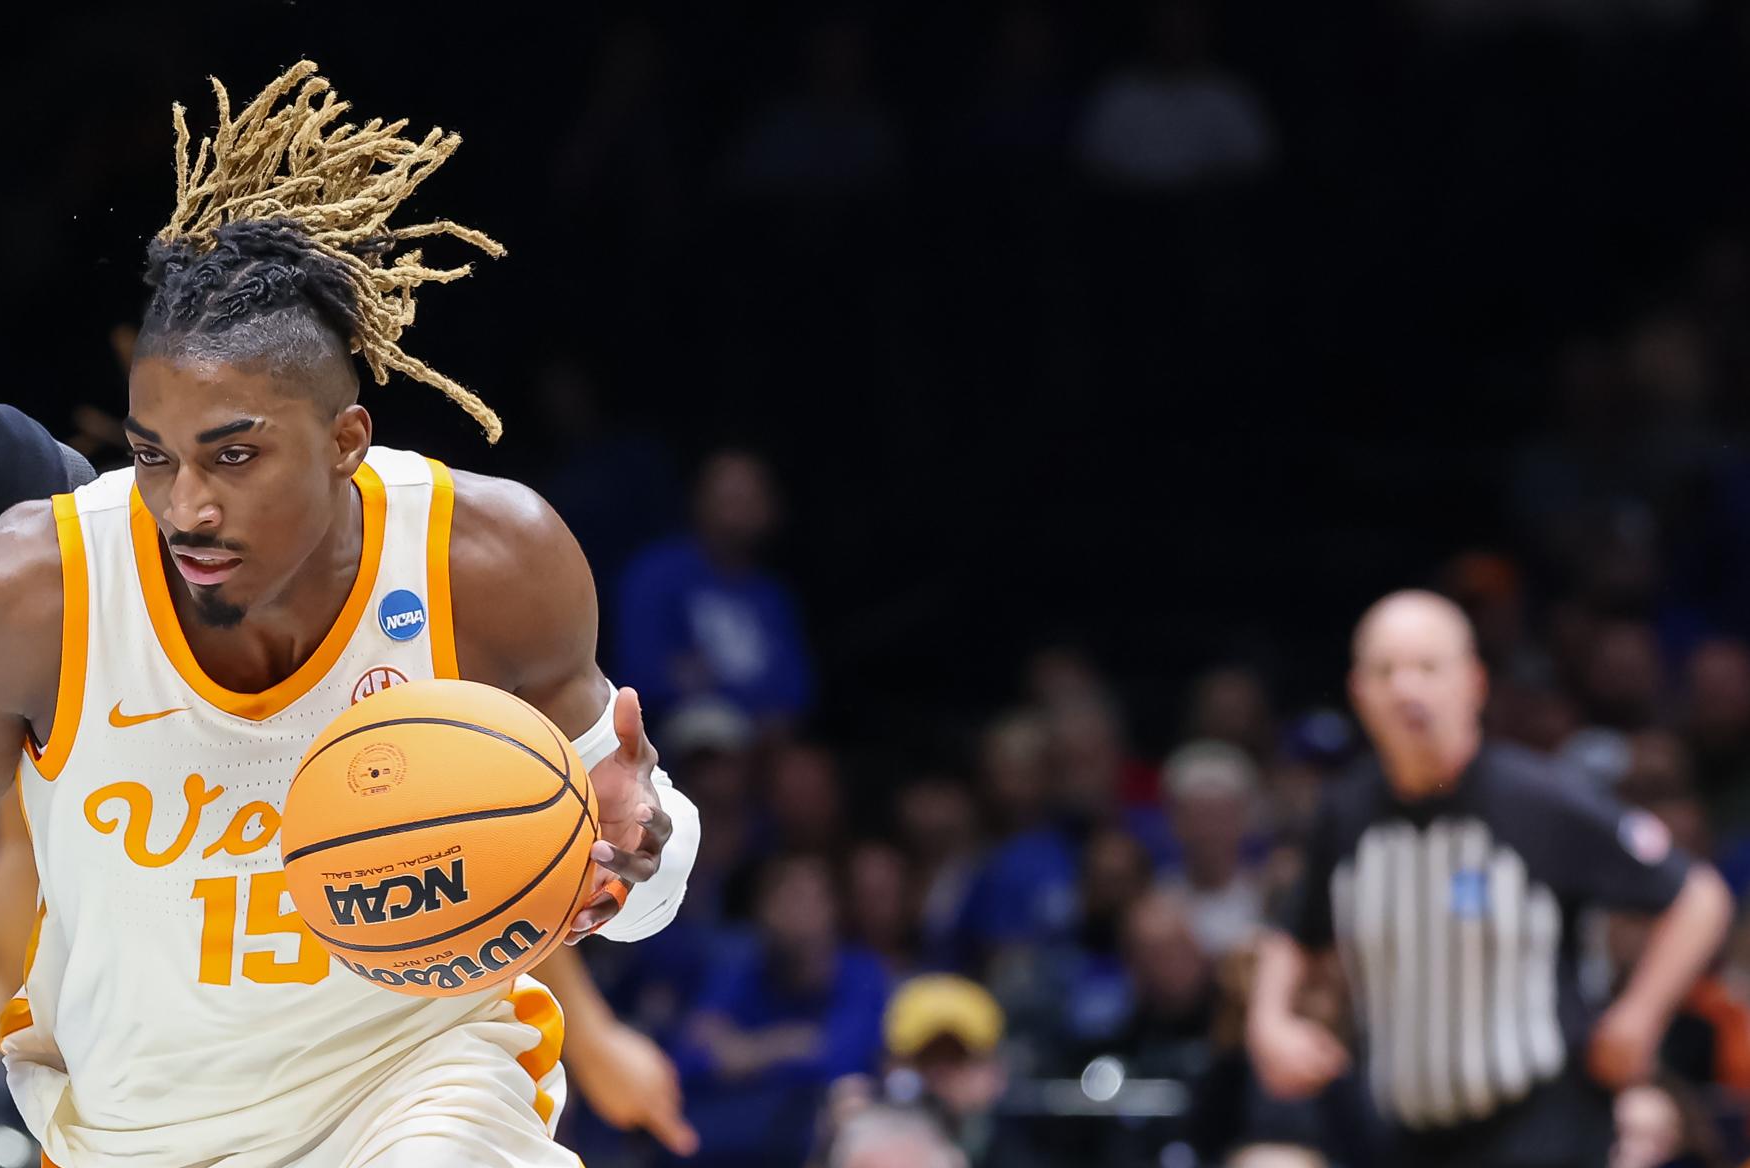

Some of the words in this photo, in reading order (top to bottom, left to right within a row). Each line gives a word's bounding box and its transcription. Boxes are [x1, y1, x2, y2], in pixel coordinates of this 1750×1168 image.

[386, 609, 425, 630] NCAA
[83, 773, 283, 868] Vo
[397, 844, 462, 868] OFFICIAL
[321, 871, 352, 880] BALL
[356, 865, 394, 878] GAME
[323, 858, 470, 926] NCAA
[190, 870, 331, 986] 15
[393, 959, 421, 968] NXT
[424, 950, 454, 963] EVO
